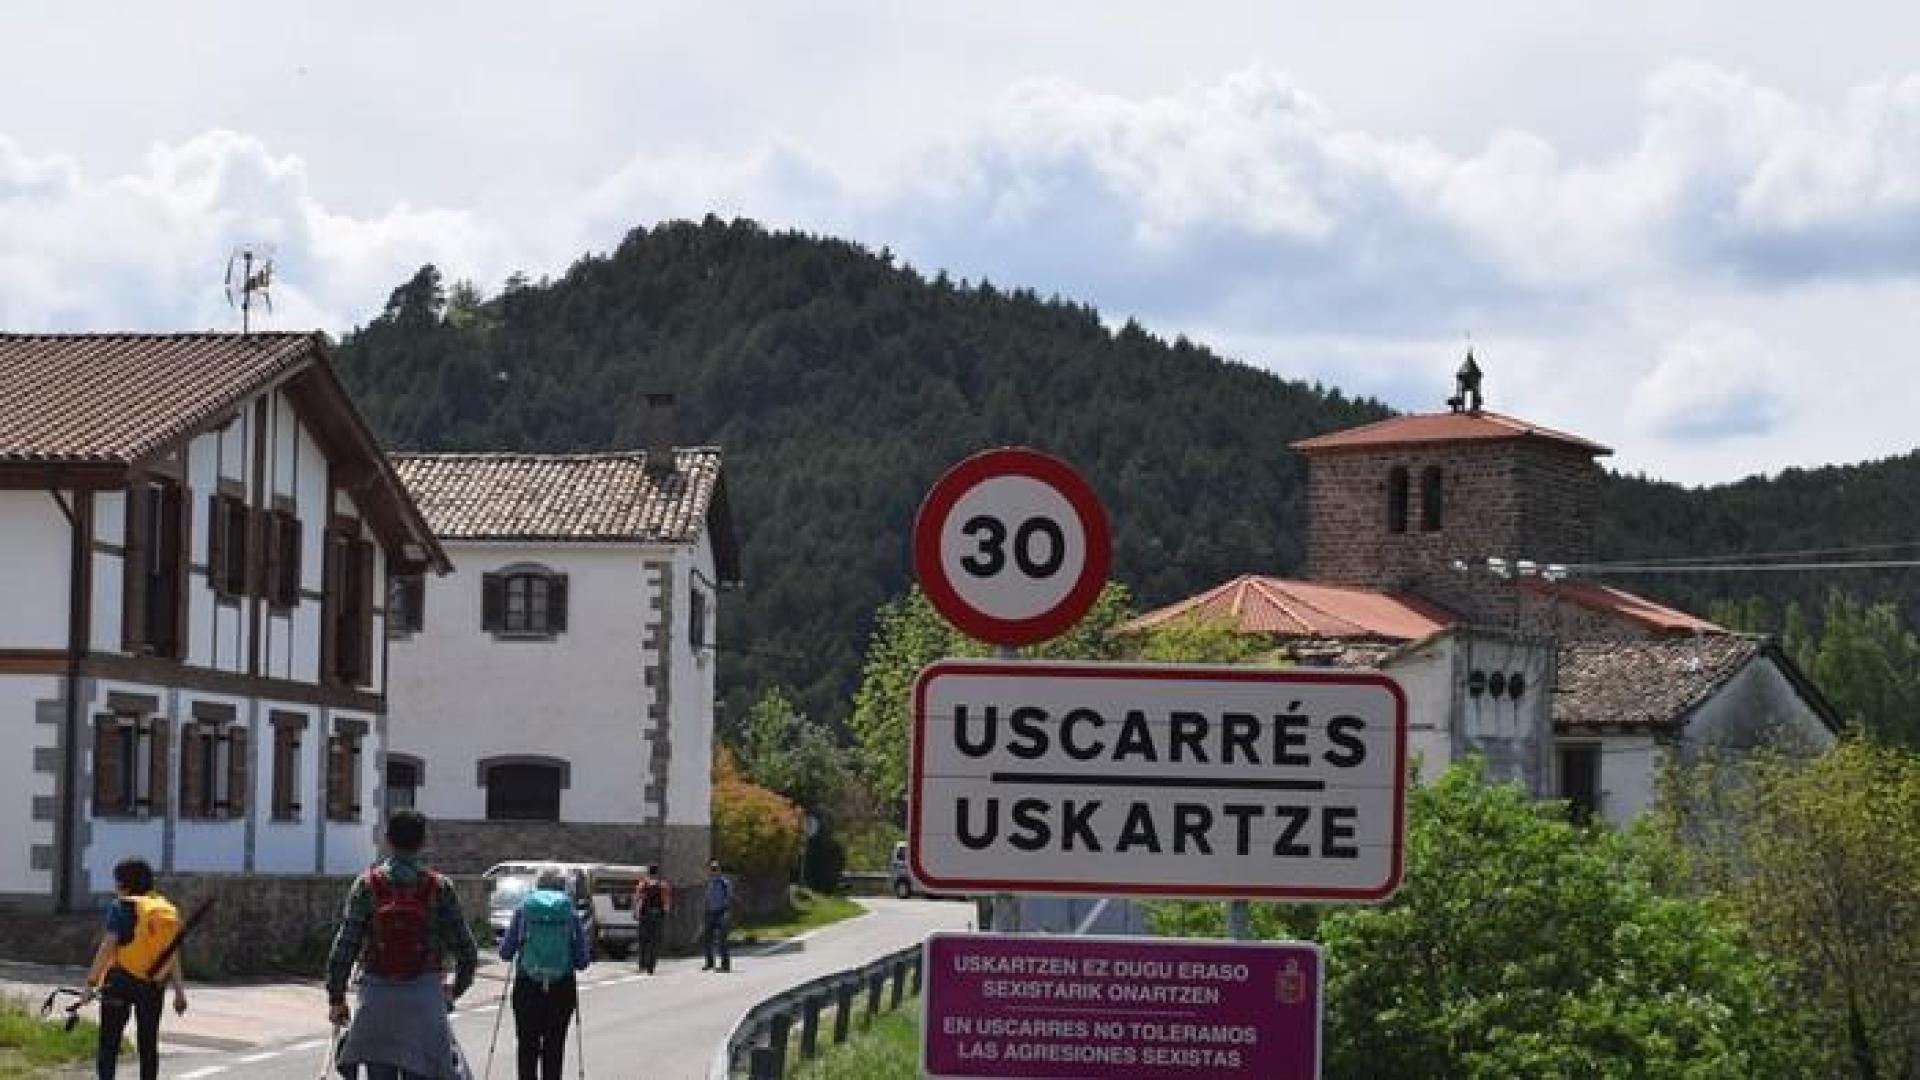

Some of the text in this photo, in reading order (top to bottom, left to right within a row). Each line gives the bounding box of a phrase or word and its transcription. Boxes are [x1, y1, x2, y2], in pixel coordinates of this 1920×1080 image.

[960, 514, 1066, 579] 30
[953, 700, 1367, 769] USCARRÉS
[955, 797, 1359, 859] USKARTZE
[954, 954, 1249, 982] USKARTZEN EZ DUGU ERASO
[982, 980, 1219, 1005] SEXISTARIK ONARTZEN
[943, 1017, 1257, 1045] EN USCARRES NO TOLERAMOS
[958, 1042, 1242, 1068] LAS AGRESIONES SEXISTAS
